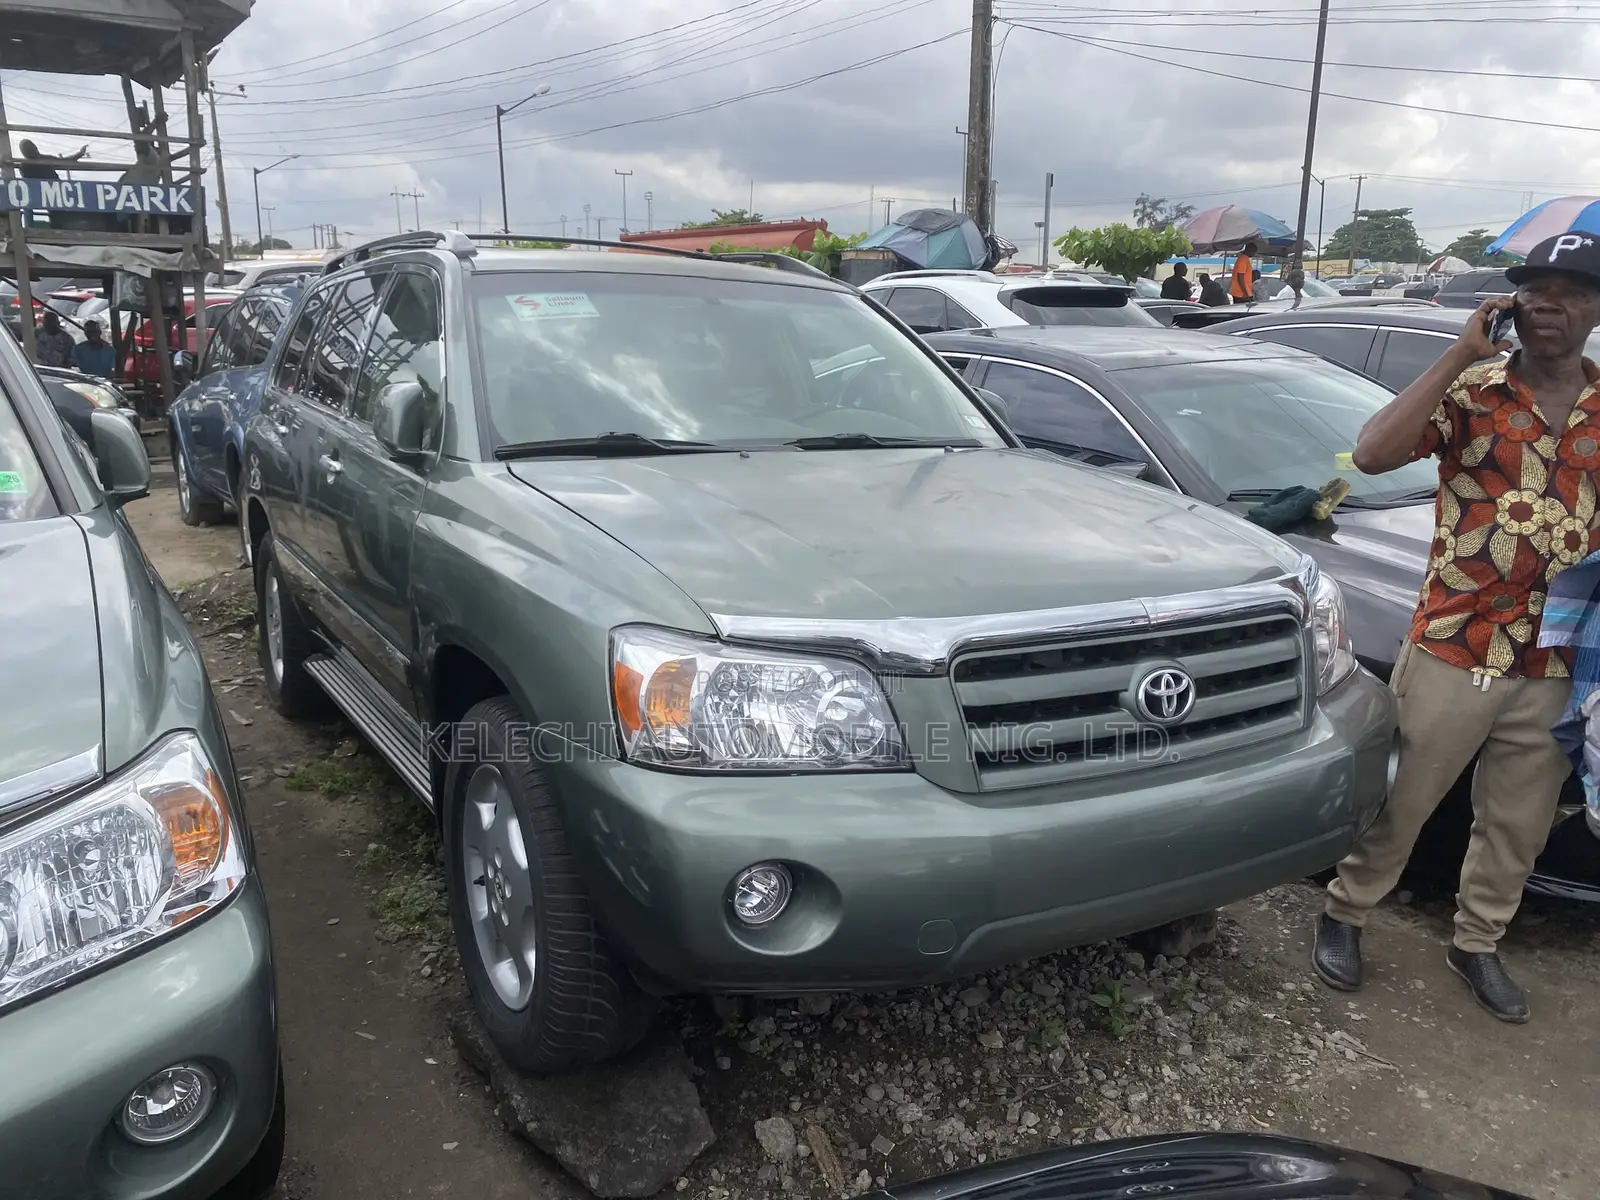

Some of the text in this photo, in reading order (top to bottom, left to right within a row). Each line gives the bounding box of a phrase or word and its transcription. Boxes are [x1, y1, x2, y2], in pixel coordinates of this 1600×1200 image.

[0, 179, 29, 207] O
[96, 184, 194, 213] PARK
[1549, 235, 1583, 262] P
